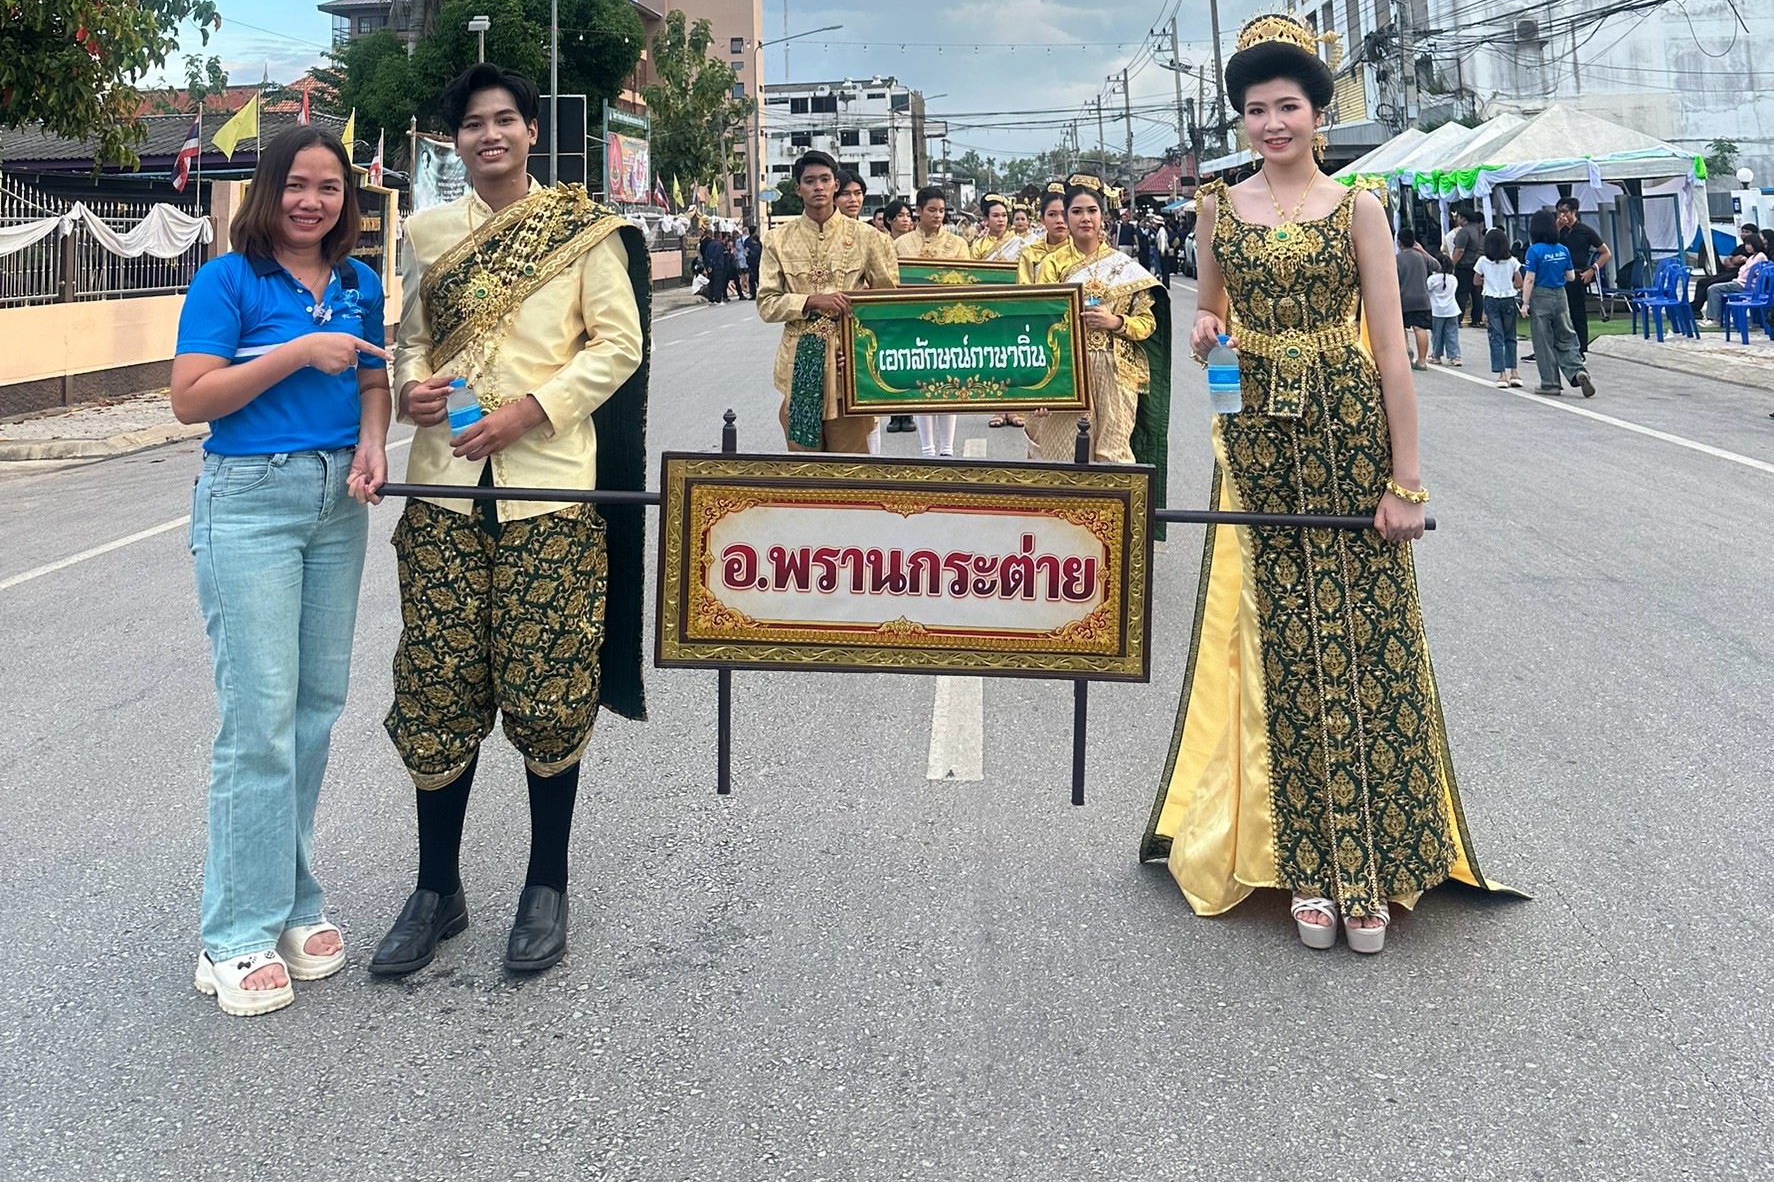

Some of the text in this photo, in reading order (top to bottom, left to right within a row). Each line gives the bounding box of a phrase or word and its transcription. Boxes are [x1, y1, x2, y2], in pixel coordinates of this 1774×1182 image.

[879, 324, 1047, 371] เอกลักษณ์ภาษาถิ่น
[722, 533, 1097, 601] อ.พรานกระต่าย
